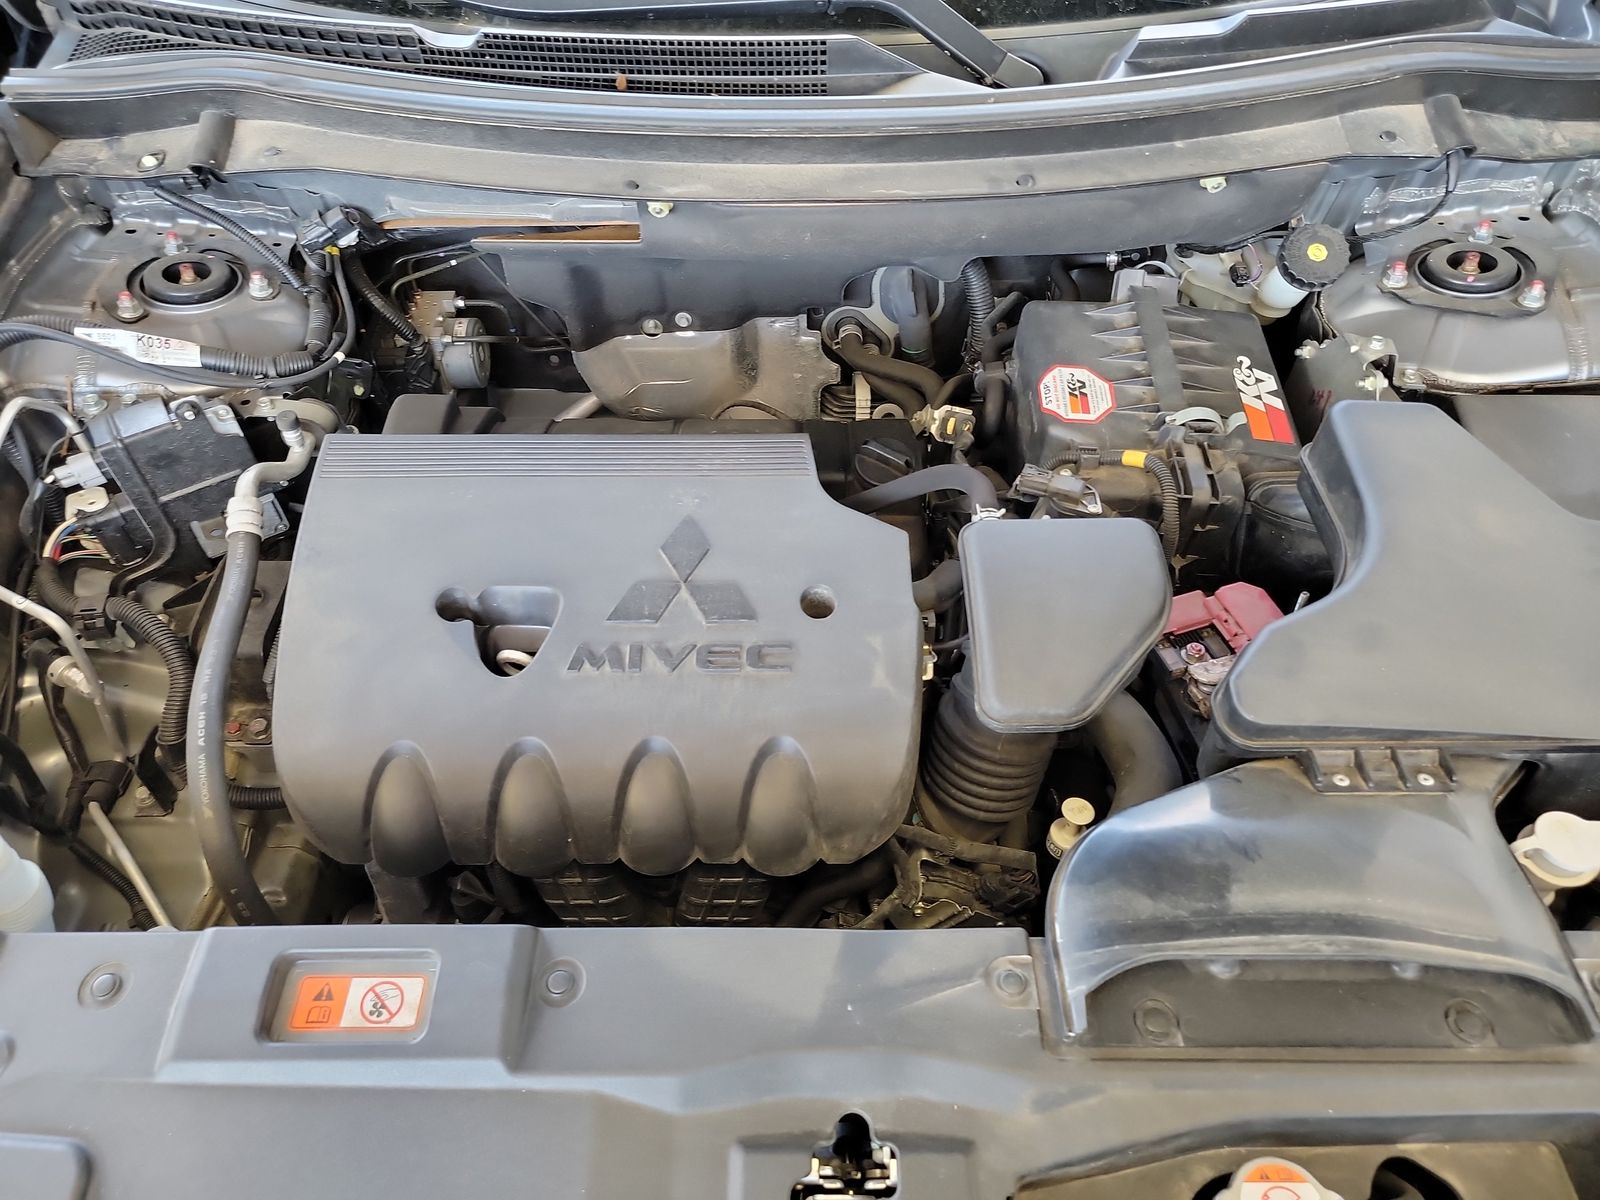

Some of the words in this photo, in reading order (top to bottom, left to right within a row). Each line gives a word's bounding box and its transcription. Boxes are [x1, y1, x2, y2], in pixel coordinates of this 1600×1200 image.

[136, 332, 172, 350] K035
[565, 641, 795, 673] MIVEC
[198, 753, 211, 803] YOKOHAMA
